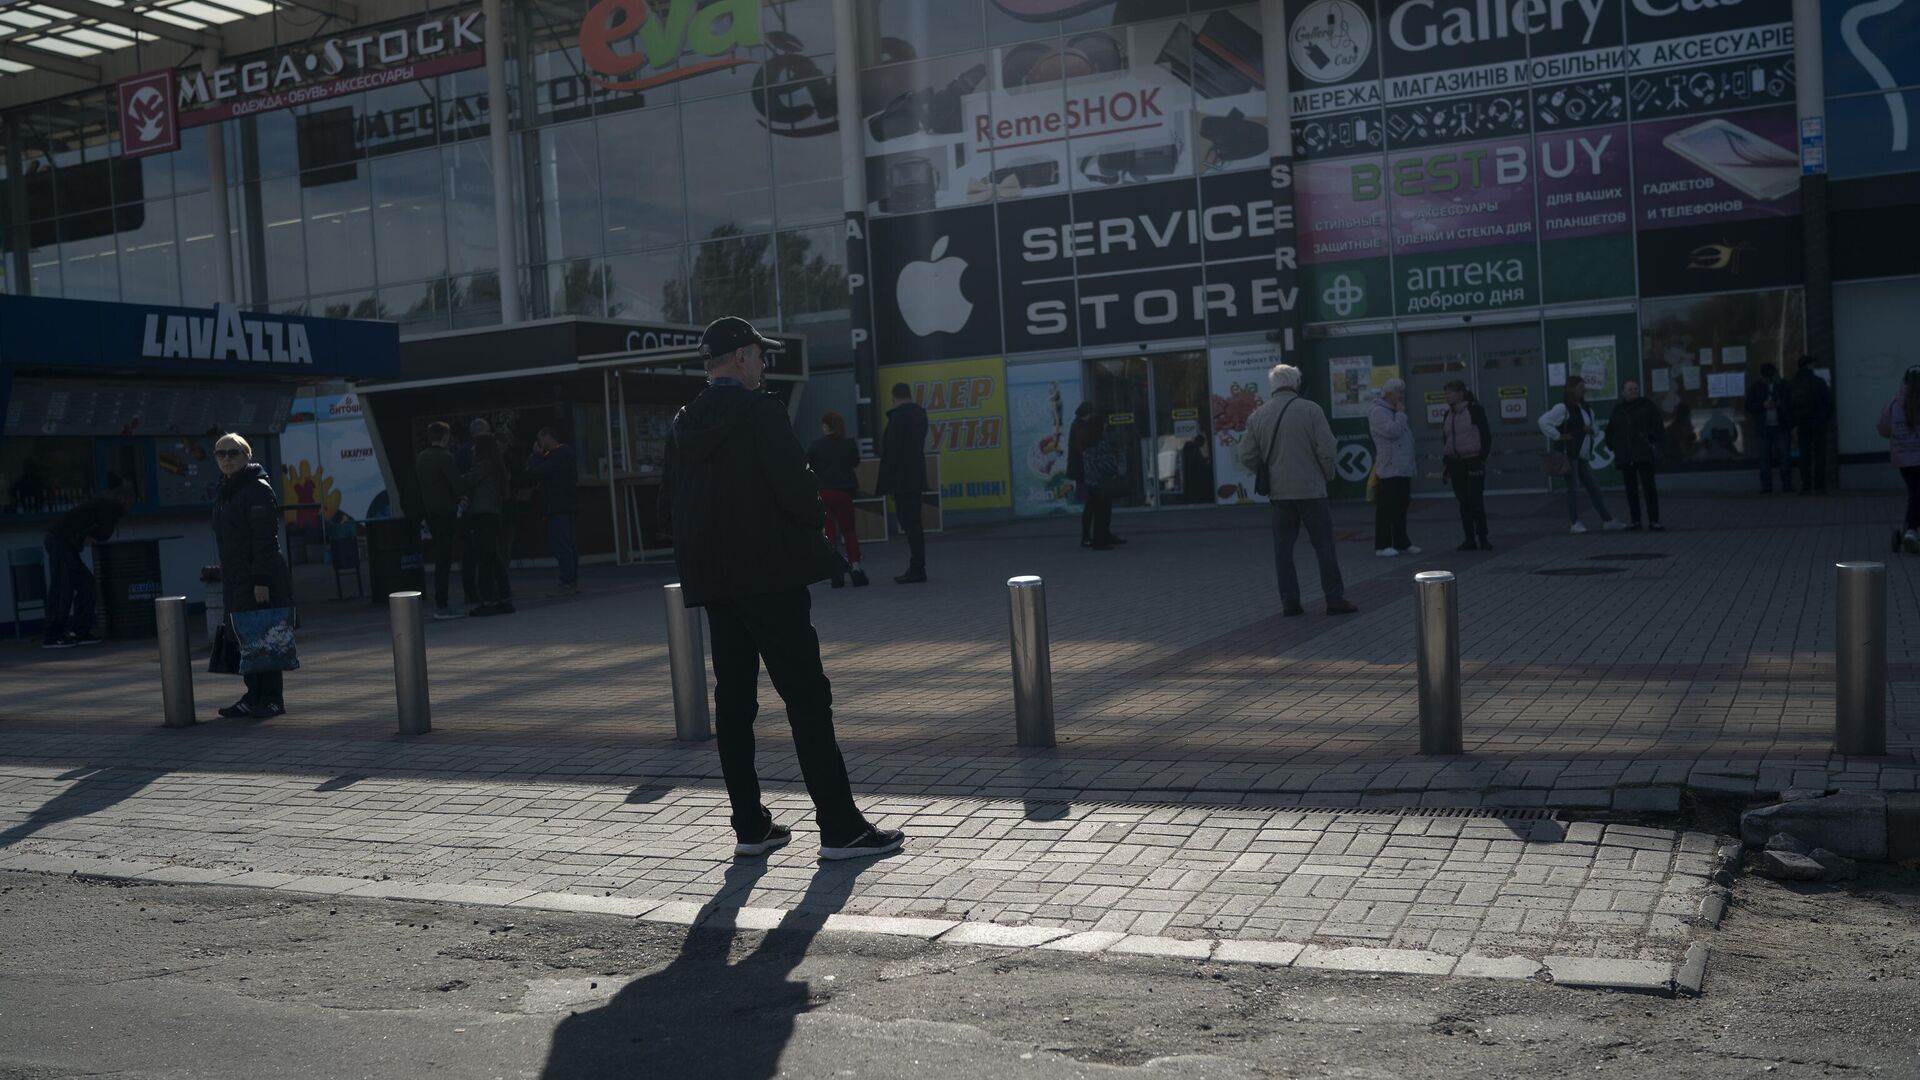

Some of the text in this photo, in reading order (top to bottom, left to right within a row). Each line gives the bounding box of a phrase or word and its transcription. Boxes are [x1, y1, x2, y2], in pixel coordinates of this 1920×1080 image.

[1389, 0, 1601, 51] Gallery
[232, 67, 415, 116] ОДЕЖДА ОБУВЬ АКСЕССУАРЫ
[1293, 83, 1381, 113] МЕРЕЖА
[1392, 61, 1508, 99] МАГАЗИНІВ
[1514, 48, 1642, 83] МОБІЛЬНИХ
[975, 87, 1164, 143] RemeSHOK
[1022, 200, 1275, 263] SERVICE
[1313, 237, 1381, 255] ЗАЩИТНЫЕ
[1449, 231, 1457, 241] И
[1457, 225, 1504, 240] СТЕКЛА
[1506, 221, 1532, 236] ДЛЯ
[1546, 211, 1627, 230] ПЛАНШЕТОВ
[1647, 209, 1657, 220] И
[1659, 199, 1743, 219] ТЕЛЕФОНОВ
[1314, 176, 1716, 232] СТИЛЬНЫЕ АКСЕССУАРЫ ДЛЯ ВАШИХ ГАДЖЕТОВ
[1406, 258, 1524, 291] аптека
[1408, 287, 1525, 313] доброго дня
[141, 302, 313, 365] LAVAZZA
[1026, 278, 1280, 336] STORE
[1505, 402, 1522, 413] GO
